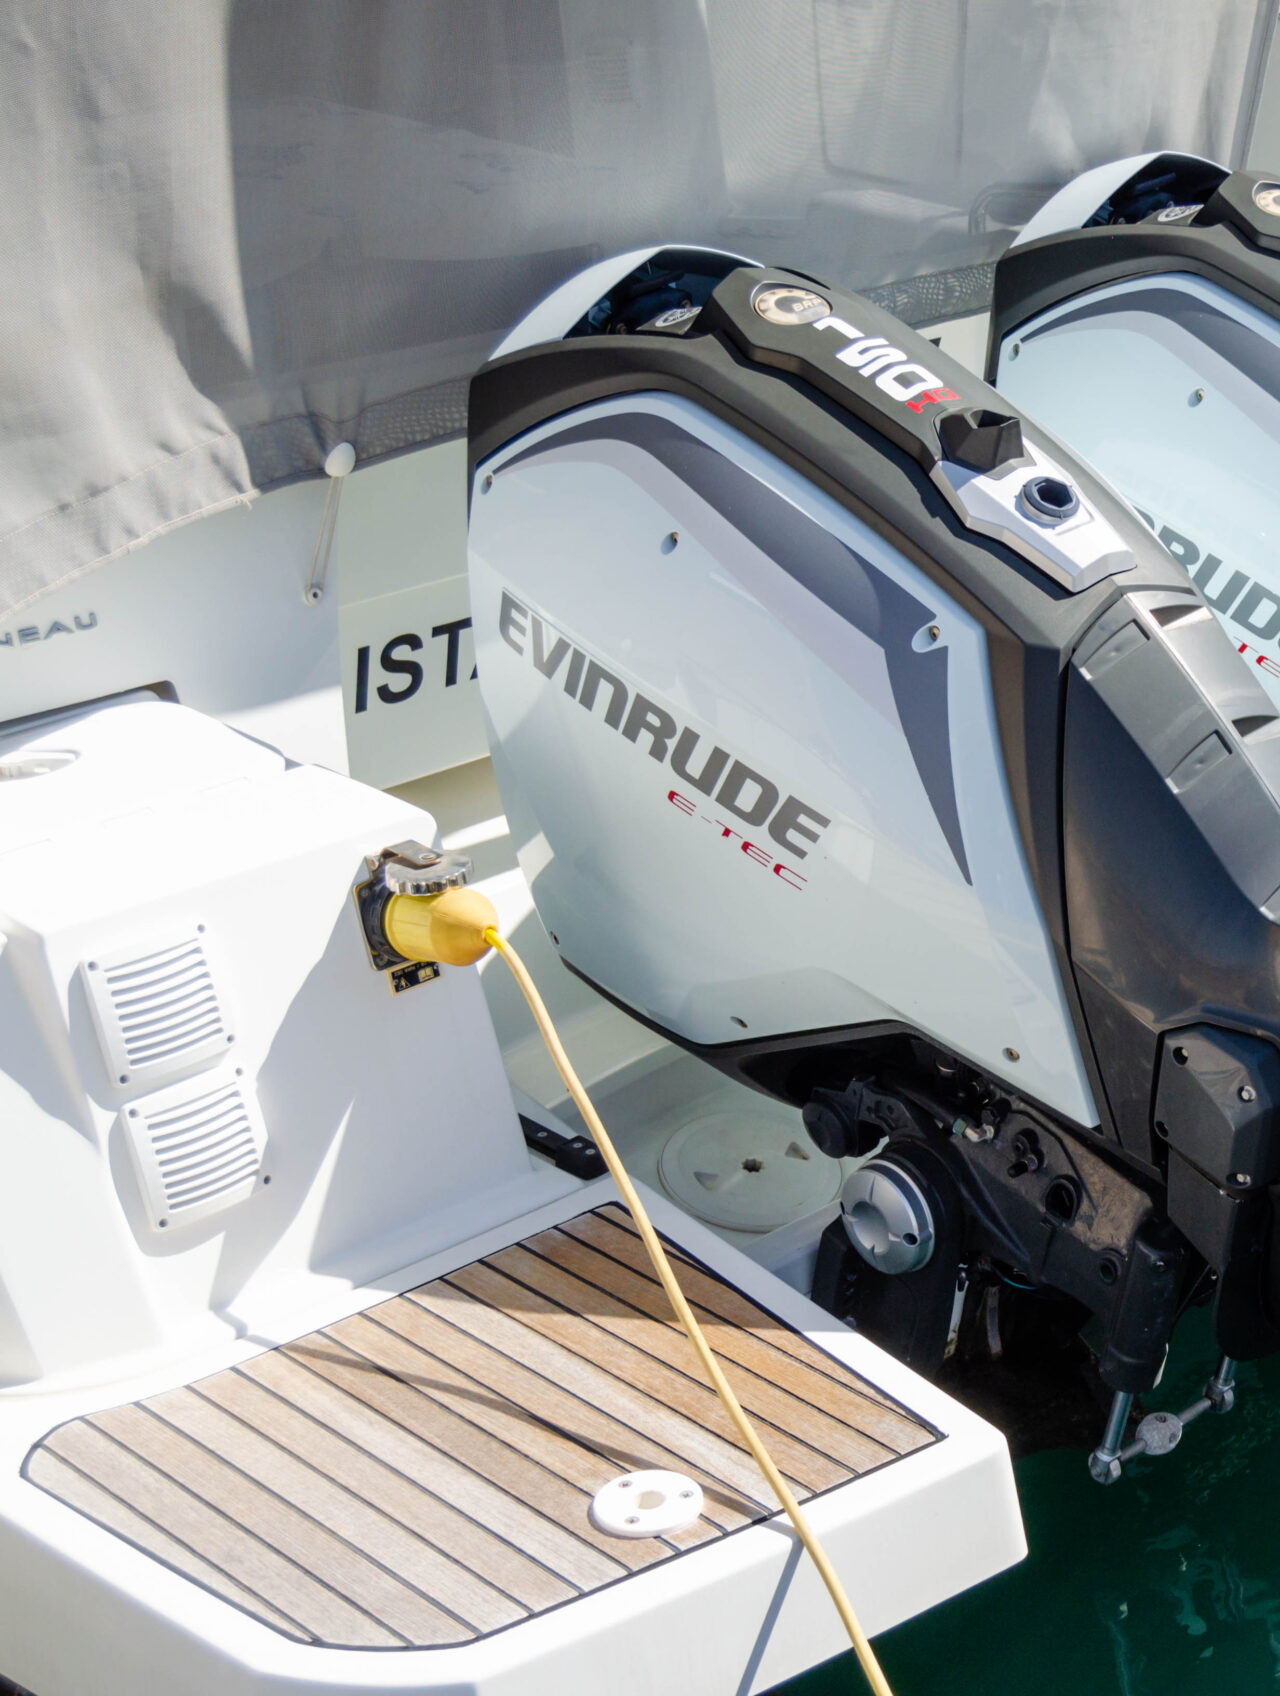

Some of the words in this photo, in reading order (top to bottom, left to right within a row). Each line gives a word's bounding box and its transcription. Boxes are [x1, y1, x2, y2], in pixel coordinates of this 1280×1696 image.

[812, 316, 944, 402] 150
[498, 589, 832, 861] EVINRUDE
[667, 789, 808, 891] E-TEC
